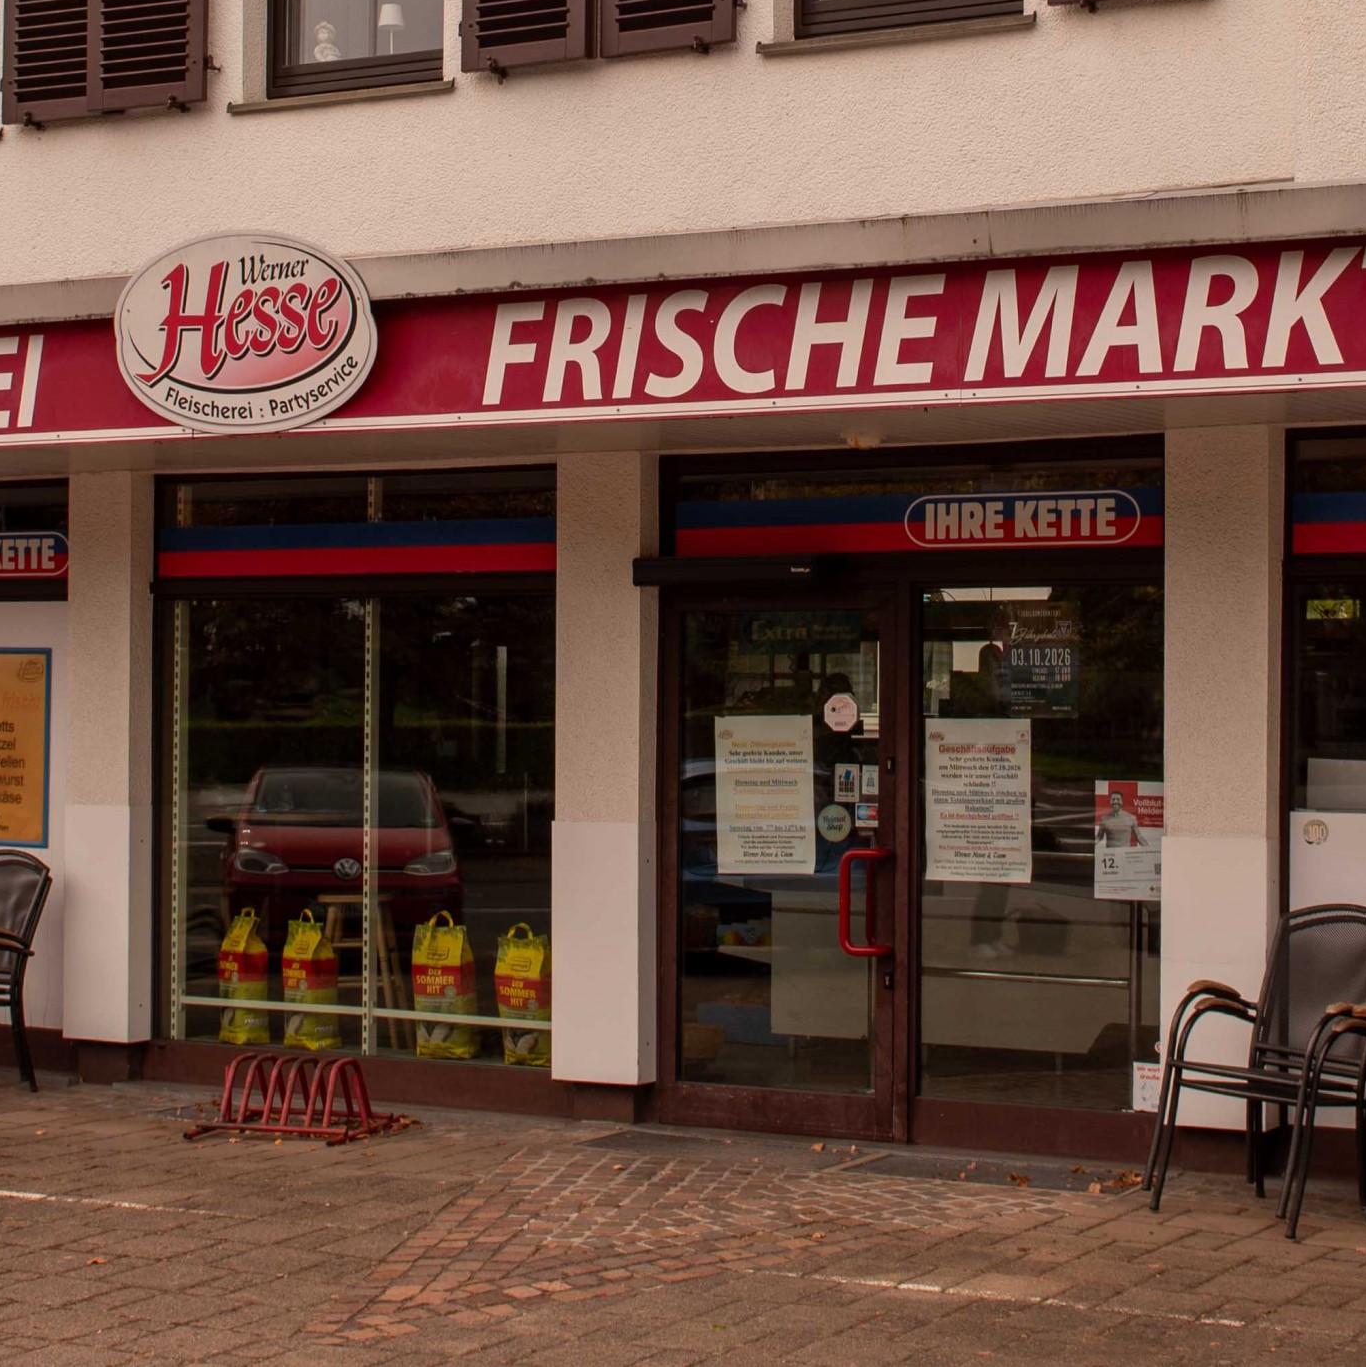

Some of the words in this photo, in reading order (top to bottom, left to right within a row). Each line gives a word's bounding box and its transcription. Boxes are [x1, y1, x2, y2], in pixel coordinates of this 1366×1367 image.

[238, 253, 309, 286] Werner
[133, 259, 343, 389] Hesse
[482, 273, 946, 406] FRISCHE
[164, 386, 253, 420] Fleischerei
[269, 354, 359, 417] Partyservice
[925, 501, 1005, 540] IHRE
[1014, 498, 1116, 538] KETTE
[1011, 648, 1071, 666] 03.10.2026
[938, 744, 1016, 755] Geschäftsaufgabe
[1102, 858, 1119, 869] 12.
[428, 968, 441, 976] DER
[416, 976, 454, 985] SOMMER
[426, 986, 440, 994] HIT
[499, 986, 536, 999] SOMMER
[510, 998, 524, 1008] HIT
